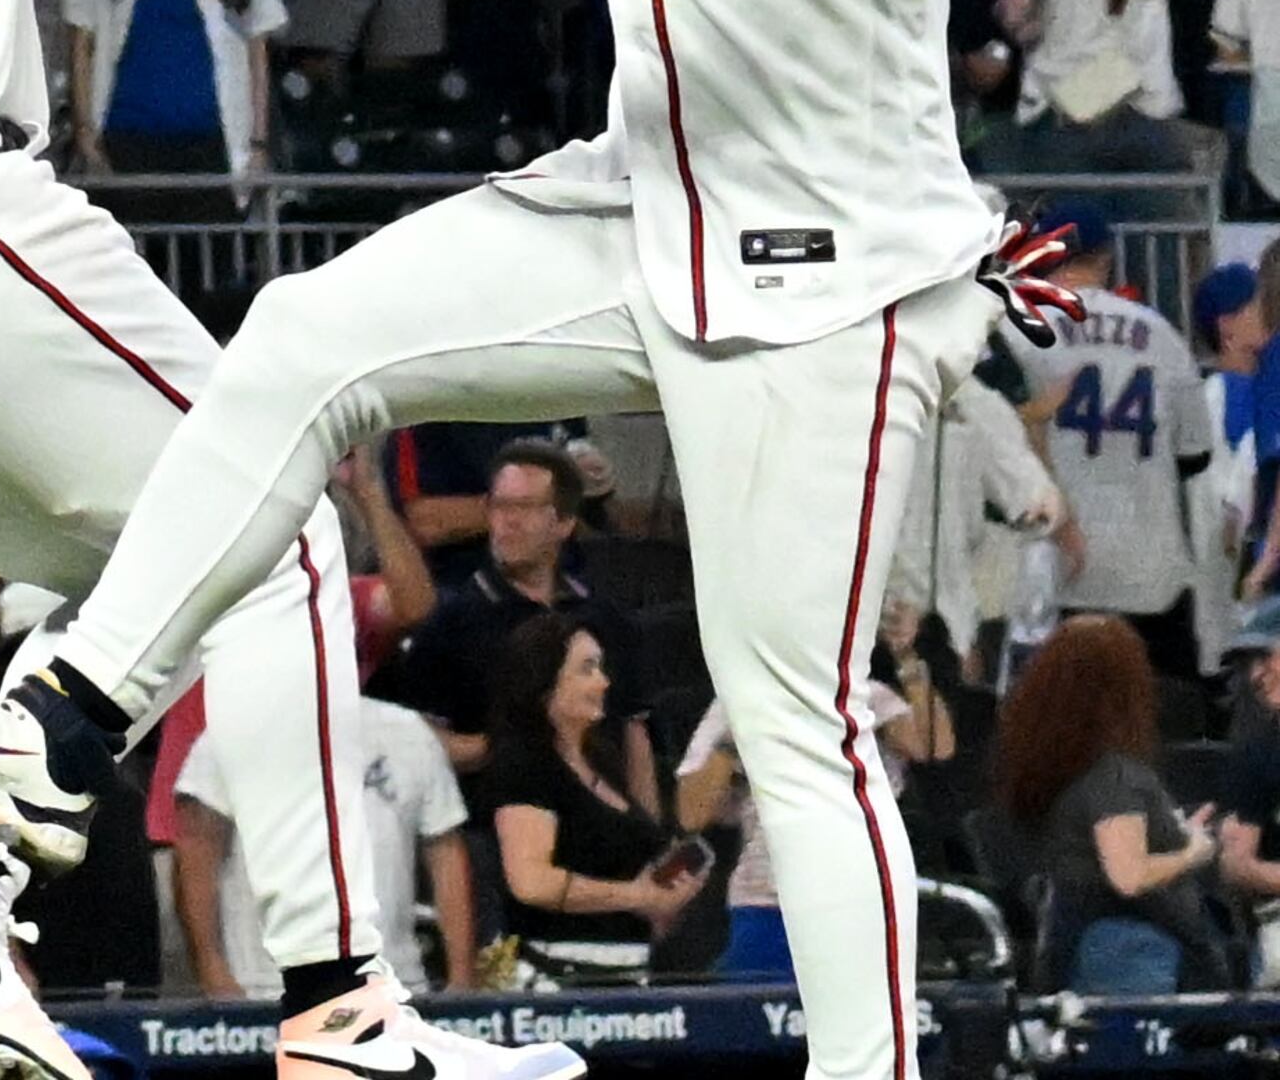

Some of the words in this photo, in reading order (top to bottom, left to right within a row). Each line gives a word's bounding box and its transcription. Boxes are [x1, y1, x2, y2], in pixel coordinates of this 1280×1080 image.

[1056, 362, 1157, 458] 44
[141, 1019, 278, 1056] Tractors
[511, 1005, 687, 1049] Equipment
